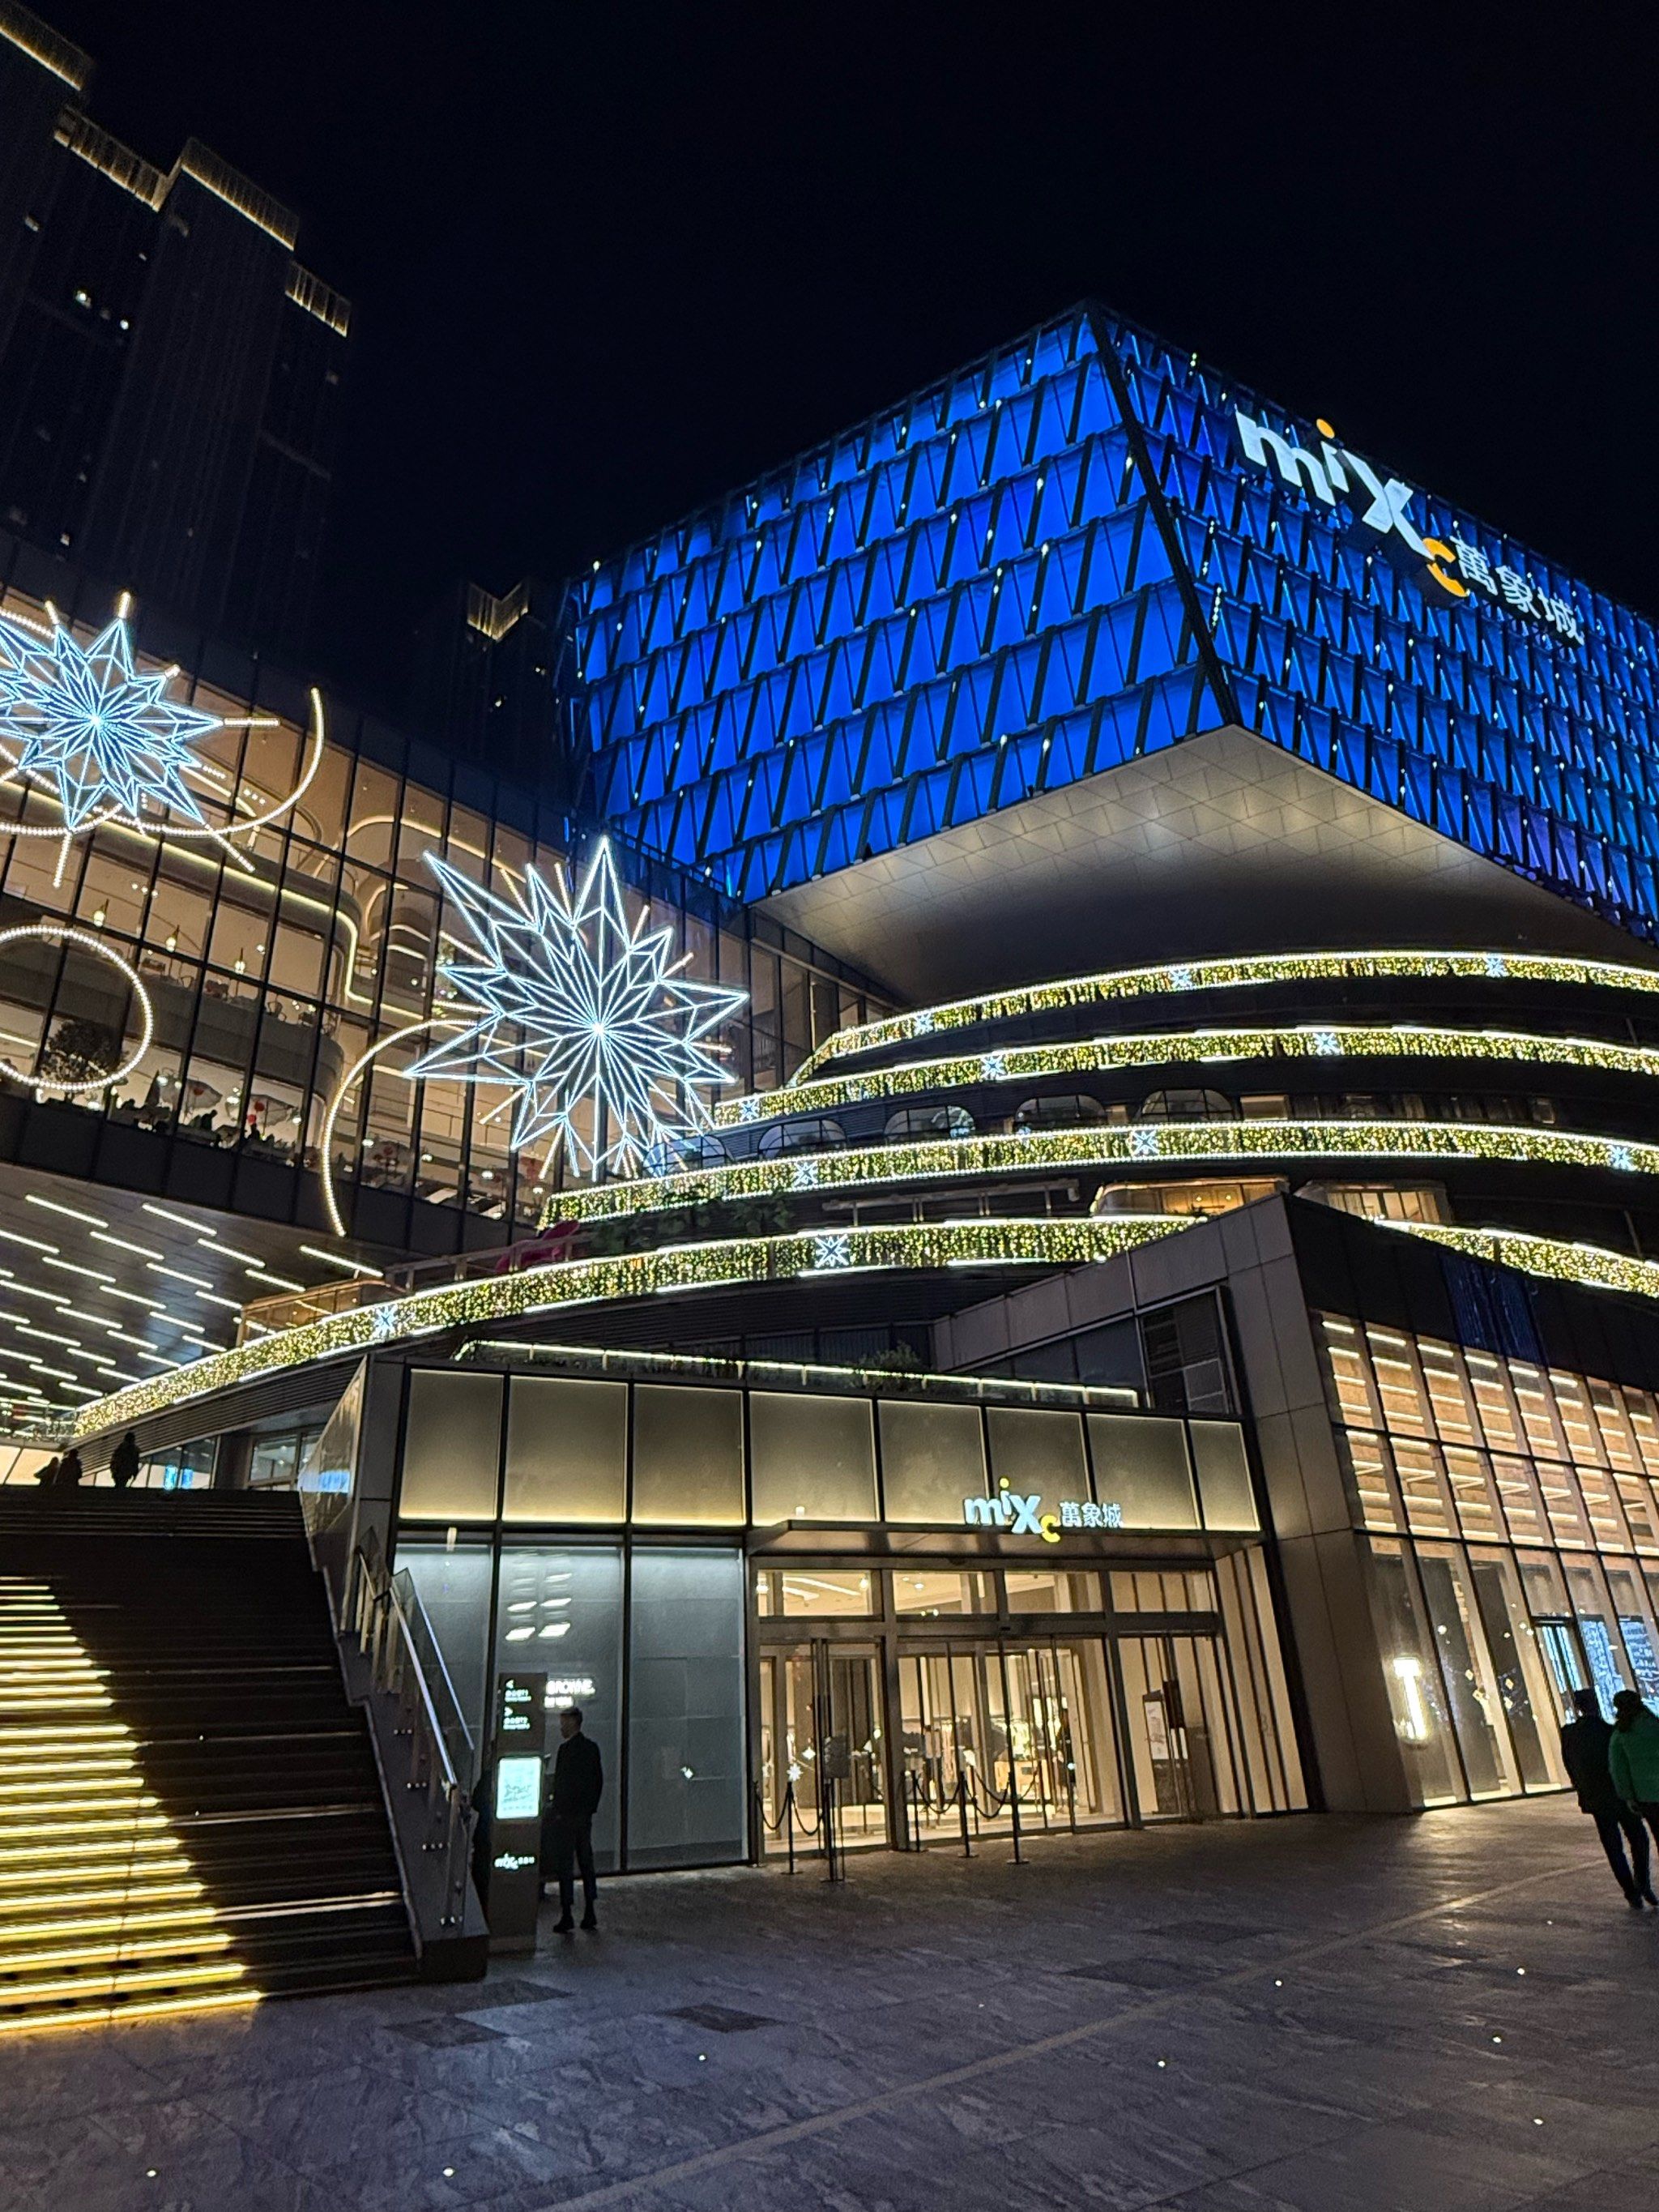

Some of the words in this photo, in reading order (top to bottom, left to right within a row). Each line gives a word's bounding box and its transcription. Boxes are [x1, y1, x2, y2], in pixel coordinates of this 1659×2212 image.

[1449, 536, 1585, 646] 萬象城
[1060, 1501, 1124, 1528] 萬象城
